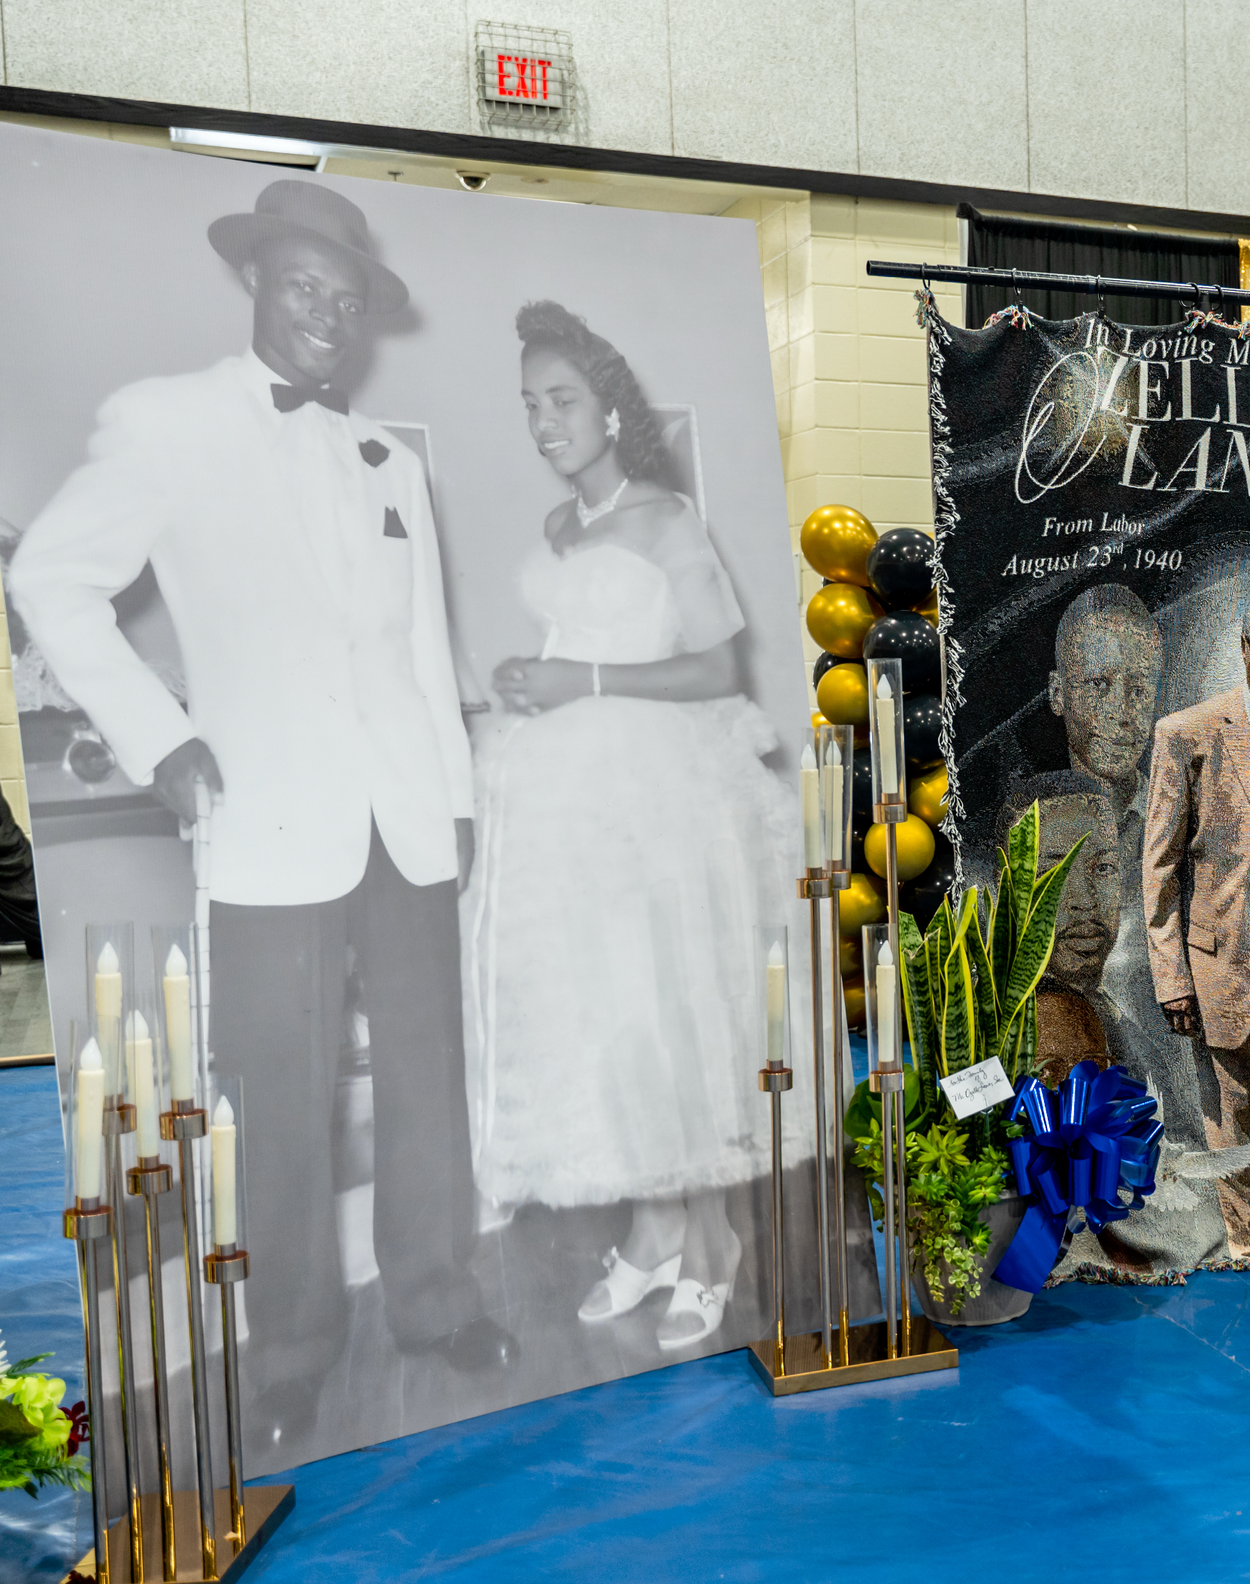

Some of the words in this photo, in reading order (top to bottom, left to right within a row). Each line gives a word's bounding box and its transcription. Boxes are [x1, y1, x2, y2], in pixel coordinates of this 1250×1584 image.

[497, 54, 552, 100] EXIT
[1085, 318, 1109, 348] In
[1122, 327, 1215, 365] Loving
[1041, 516, 1093, 537] From
[1101, 512, 1145, 535] Labor
[1001, 551, 1079, 579] August
[1134, 548, 1183, 571] 1940
